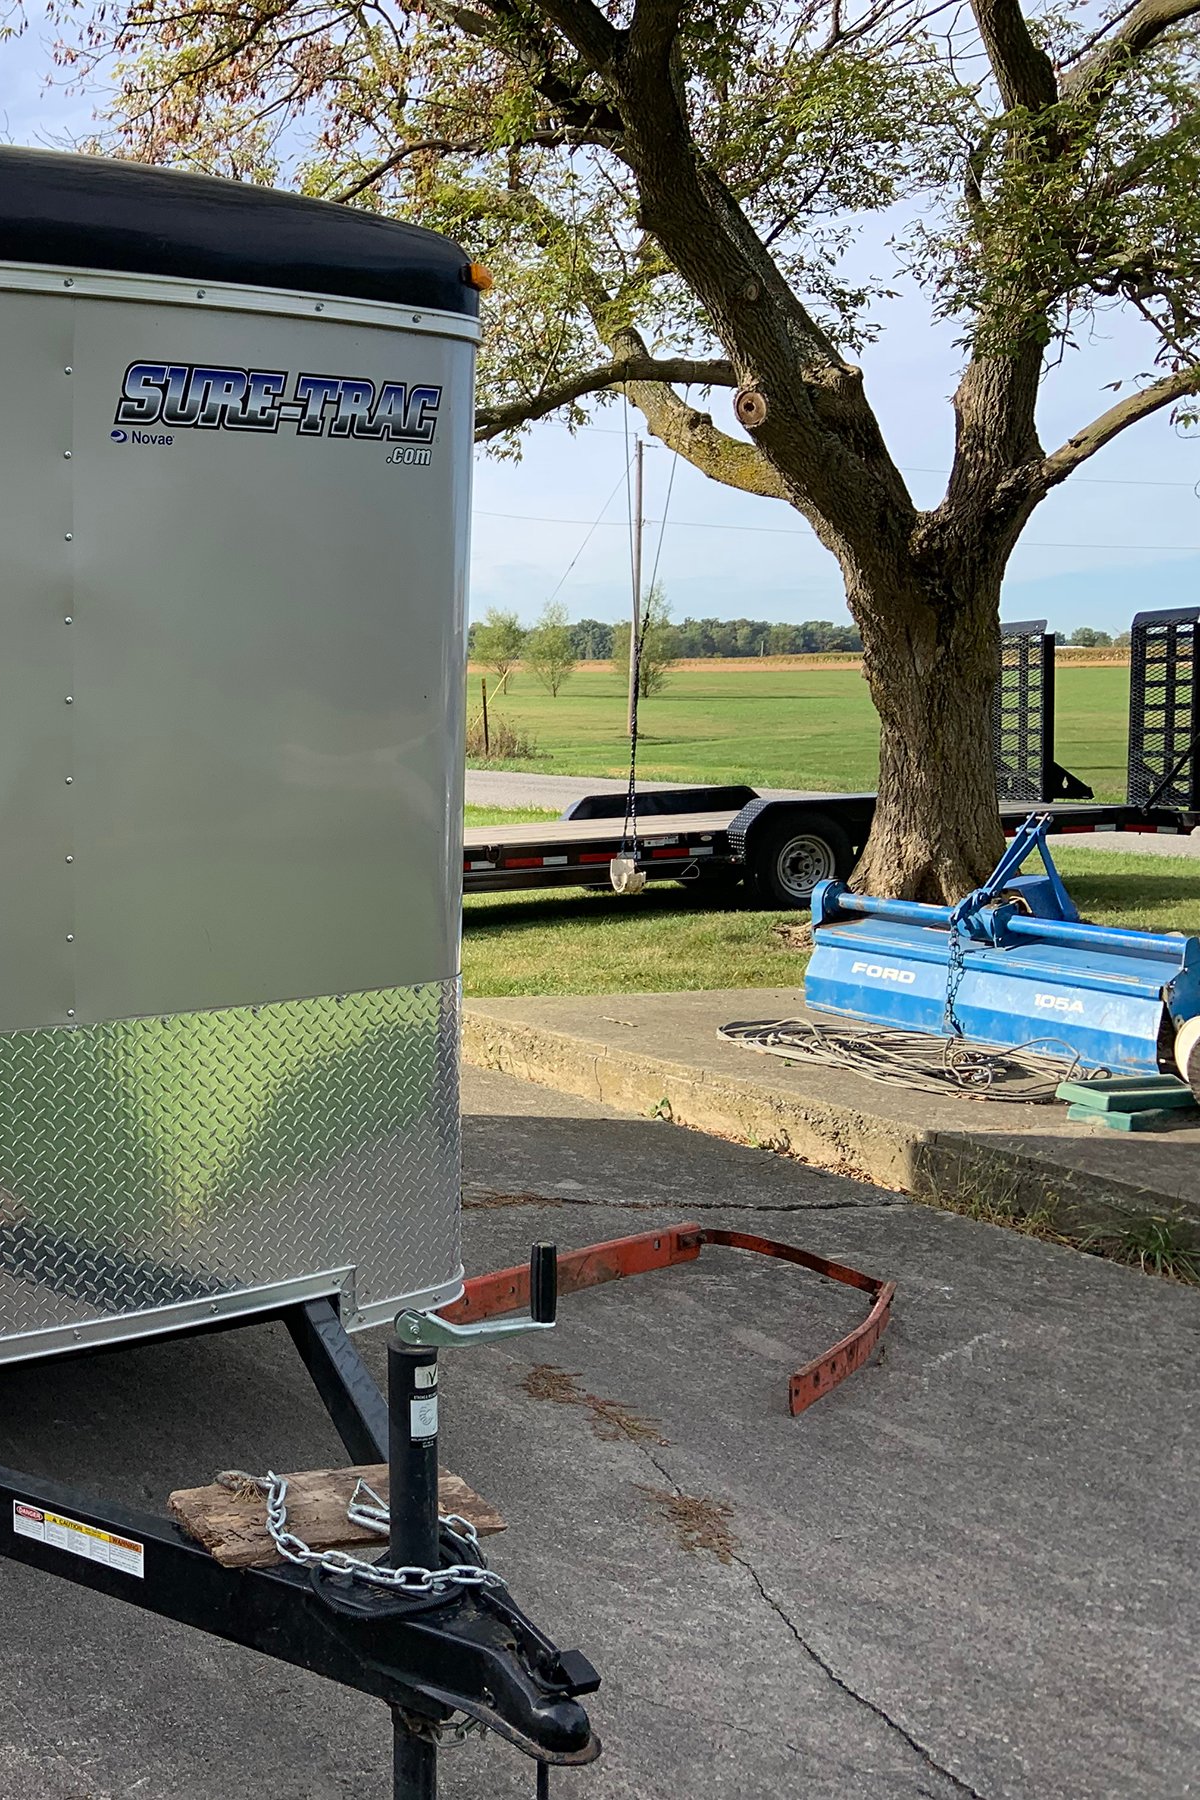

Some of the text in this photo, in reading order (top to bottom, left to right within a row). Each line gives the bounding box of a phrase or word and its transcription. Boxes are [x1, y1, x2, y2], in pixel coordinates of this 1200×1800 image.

[114, 359, 443, 445] SURE-TRAC
[131, 430, 174, 446] Novae
[385, 446, 432, 466] .com
[851, 961, 917, 984] FORD
[1034, 993, 1084, 1014] 105A
[59, 1518, 83, 1532] CAUTION
